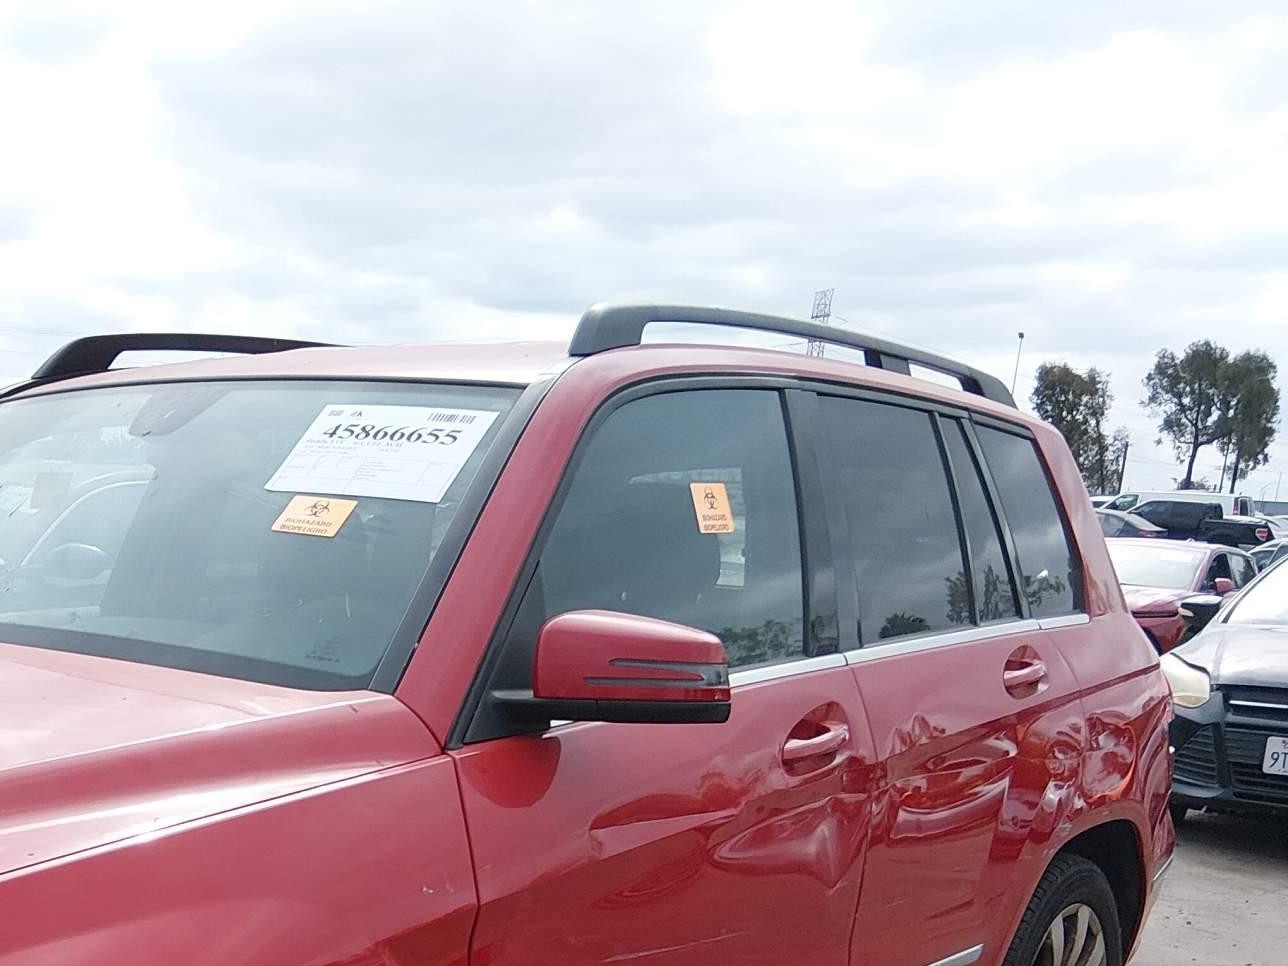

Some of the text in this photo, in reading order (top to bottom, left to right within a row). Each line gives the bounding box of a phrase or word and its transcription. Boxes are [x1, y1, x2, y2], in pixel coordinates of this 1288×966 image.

[323, 423, 463, 446] 45866655
[285, 517, 334, 528] BIOHAZARD
[279, 523, 329, 534] BIOPELIGRO
